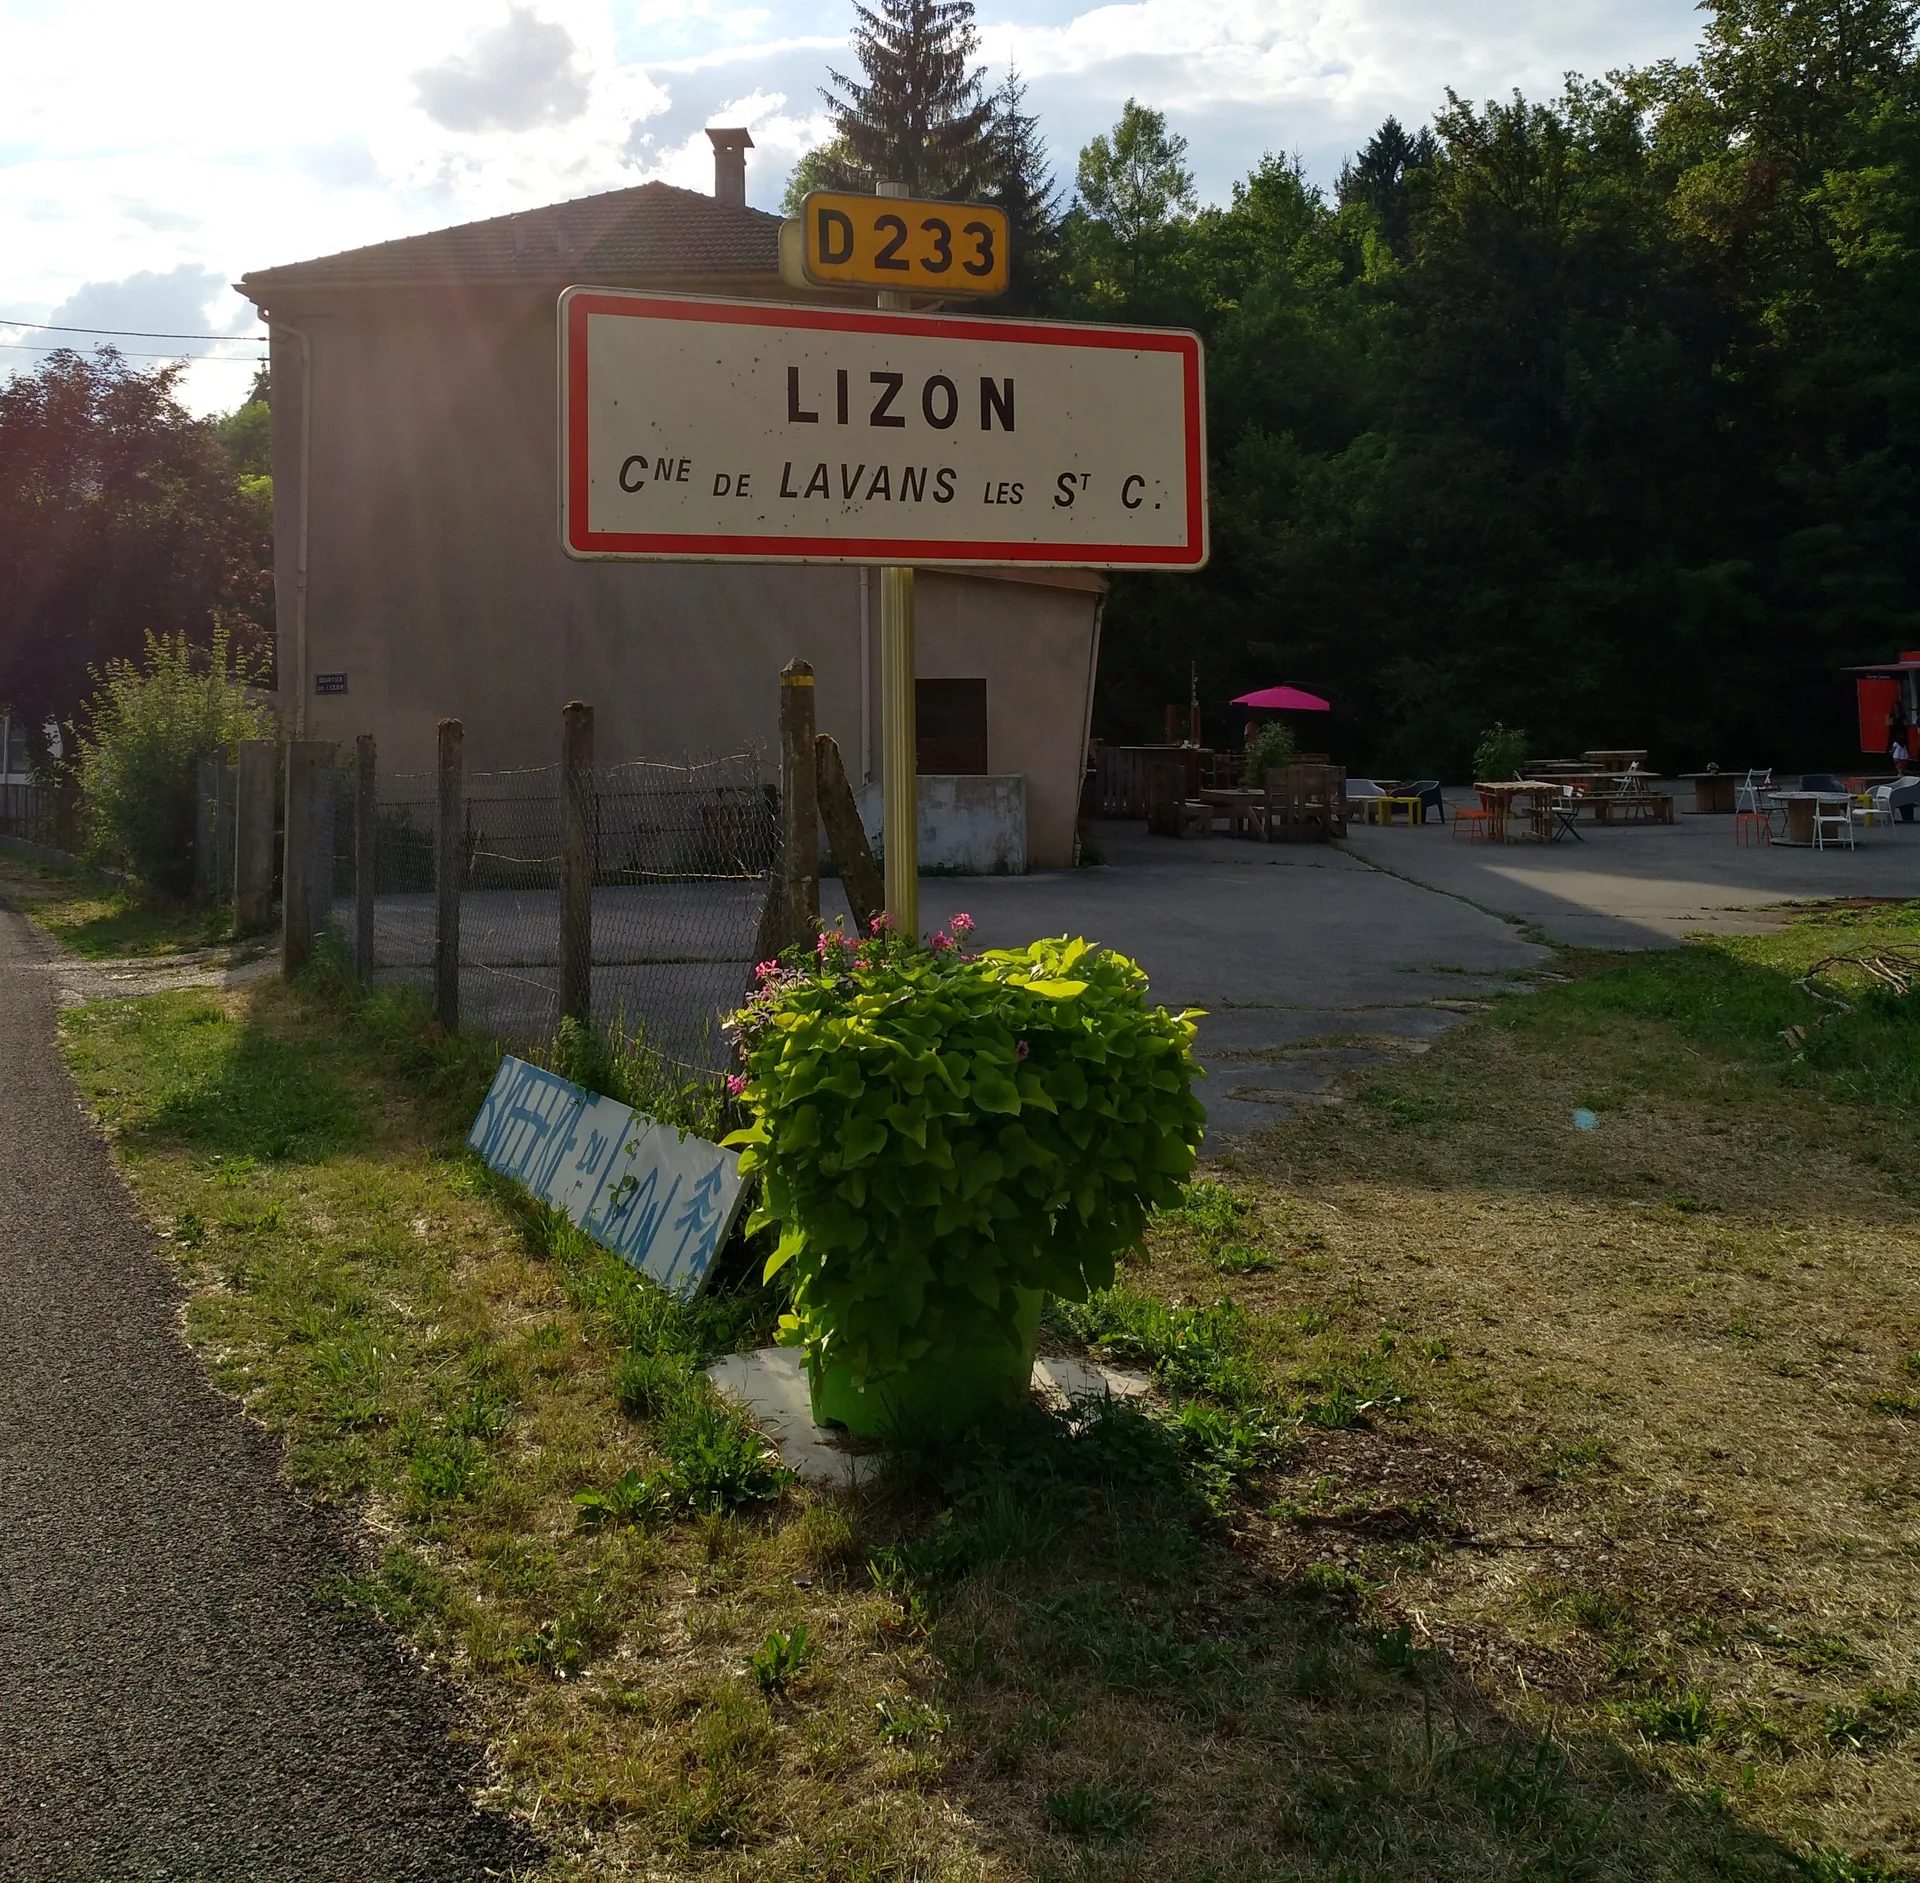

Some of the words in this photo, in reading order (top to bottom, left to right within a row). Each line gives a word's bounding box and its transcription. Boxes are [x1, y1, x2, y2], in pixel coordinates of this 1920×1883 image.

[818, 209, 854, 264] D
[874, 215, 994, 276] 233
[787, 366, 1016, 432] LIZON
[712, 473, 751, 498] DE
[779, 461, 957, 503] LAVANS
[983, 481, 1024, 506] LES
[1053, 472, 1091, 508] ST
[1121, 475, 1162, 510] C.
[574, 1128, 608, 1175] DU
